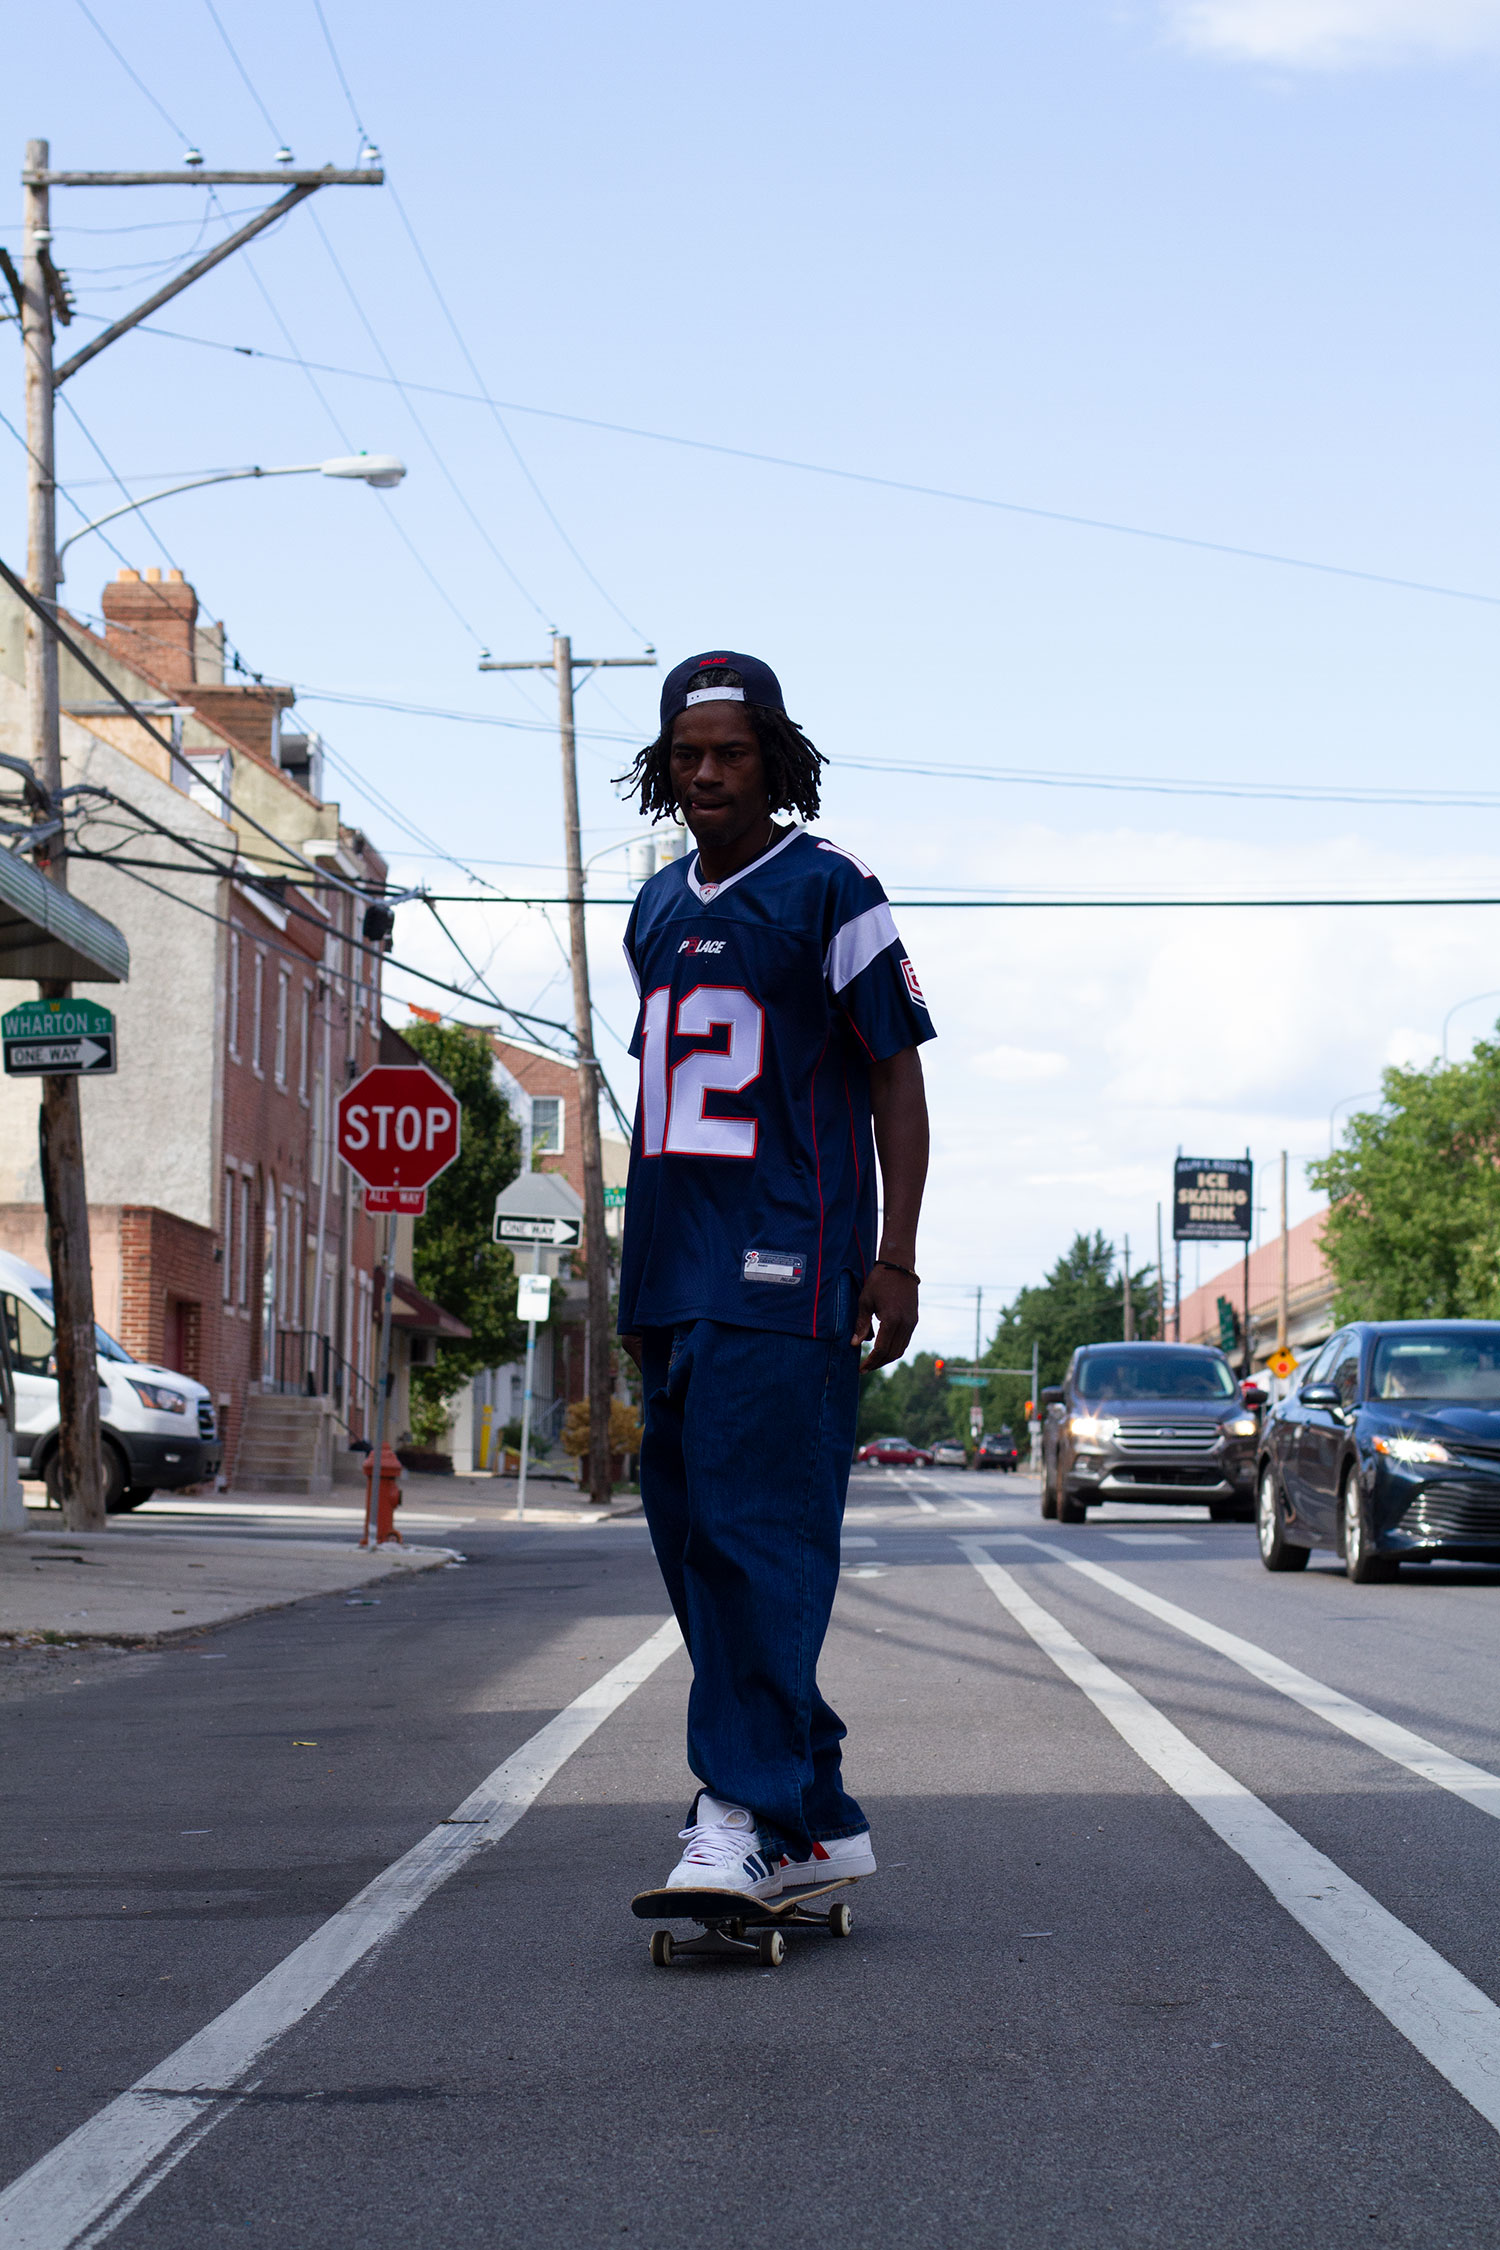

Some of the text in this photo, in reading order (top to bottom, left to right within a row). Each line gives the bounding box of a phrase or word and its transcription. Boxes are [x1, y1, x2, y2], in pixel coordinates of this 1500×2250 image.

[4, 1012, 107, 1036] WHARTON ST
[14, 1047, 79, 1064] ONE WAY
[641, 984, 765, 1159] 12
[344, 1104, 451, 1152] STOP
[1197, 1172, 1228, 1188] ICE
[368, 1190, 421, 1205] ALL WAY
[1178, 1188, 1247, 1206] SKATING
[1189, 1205, 1236, 1221] RINK
[503, 1223, 553, 1237] ONE WAY
